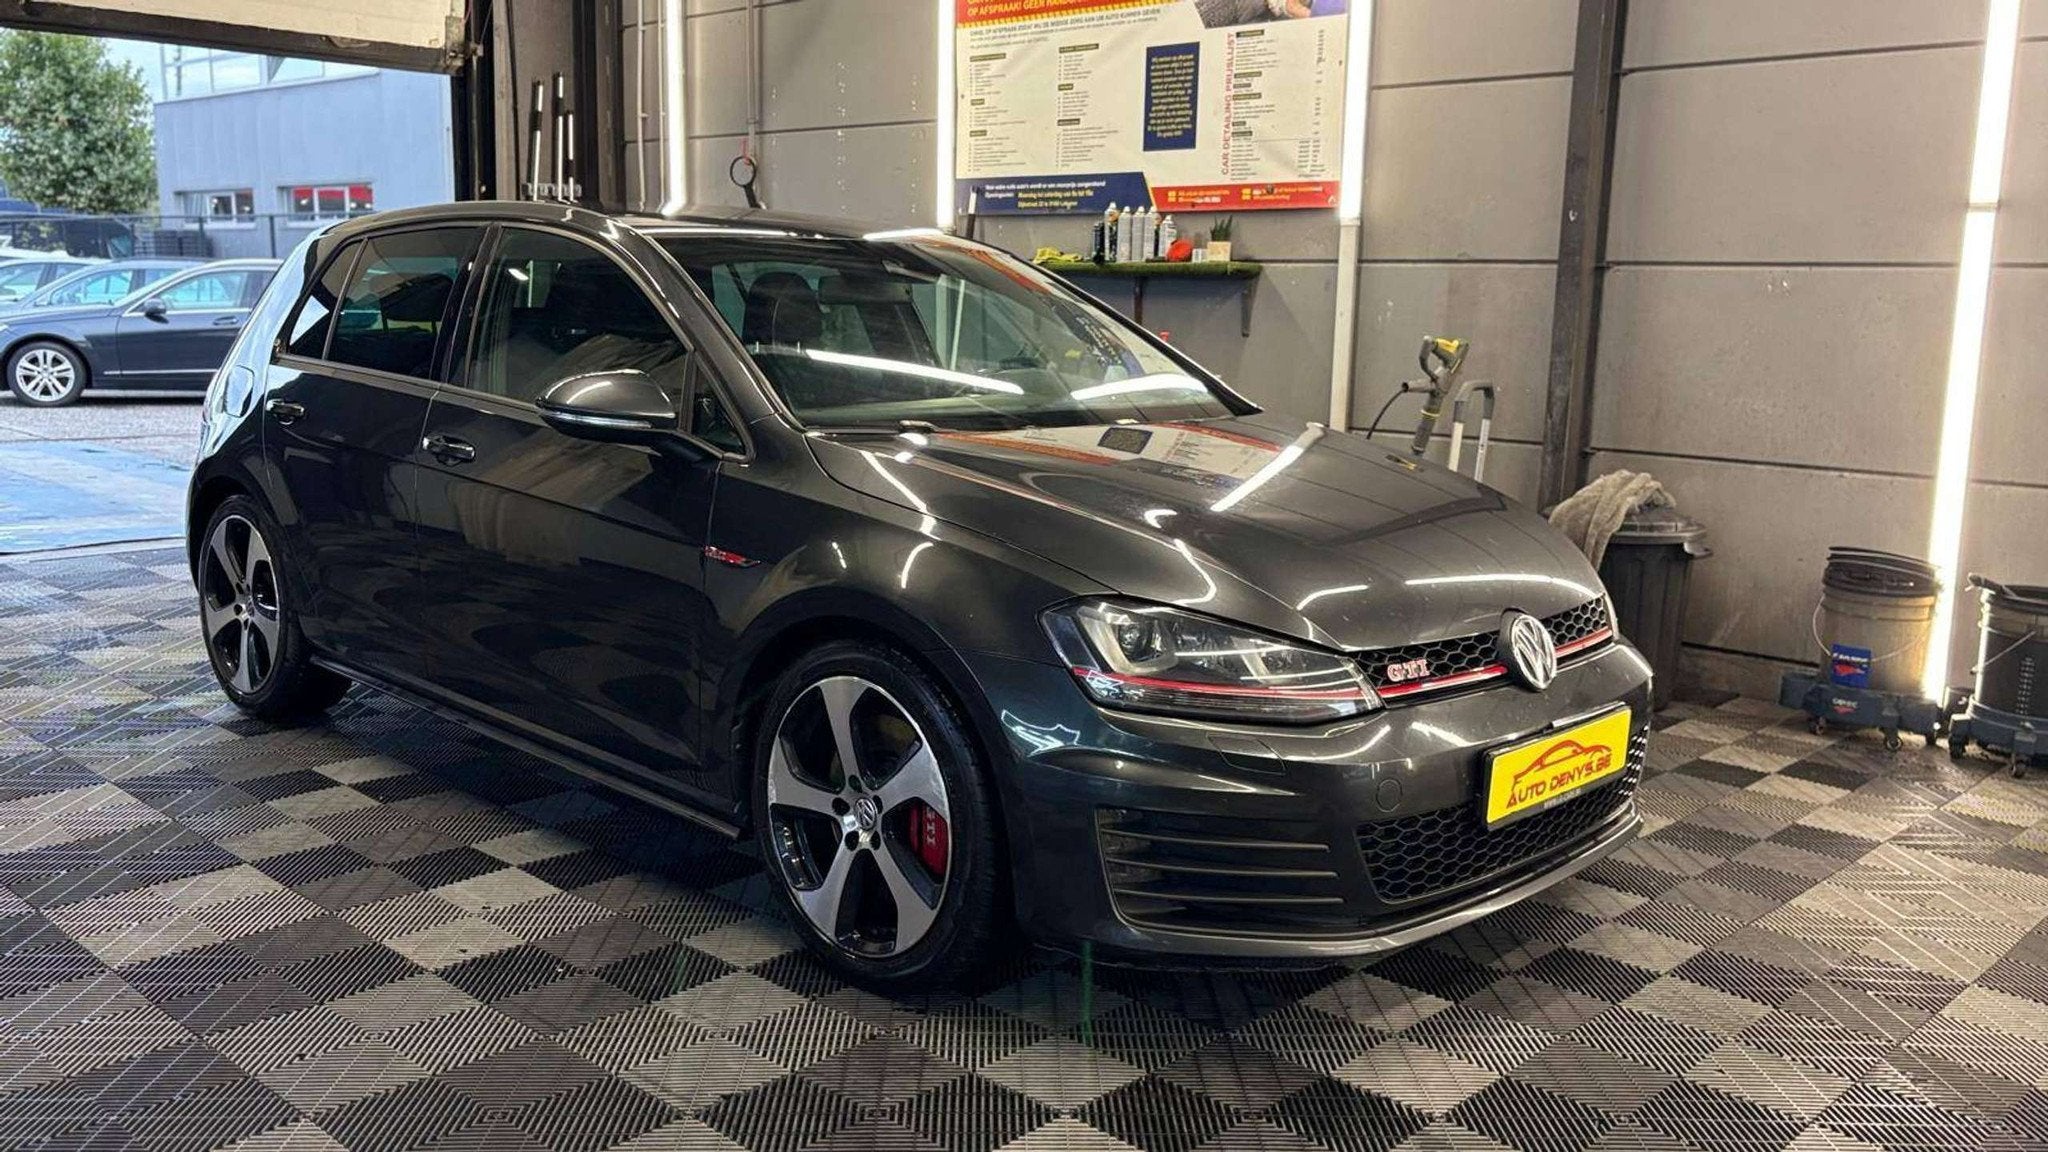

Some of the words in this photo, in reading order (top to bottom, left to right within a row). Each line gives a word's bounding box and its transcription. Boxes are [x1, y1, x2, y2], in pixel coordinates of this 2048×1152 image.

[1222, 95, 1232, 150] DETAILING
[1222, 153, 1230, 175] CAR
[1387, 657, 1430, 682] GTI
[1506, 780, 1547, 809] AUTO
[1550, 754, 1612, 792] DENYS.BE
